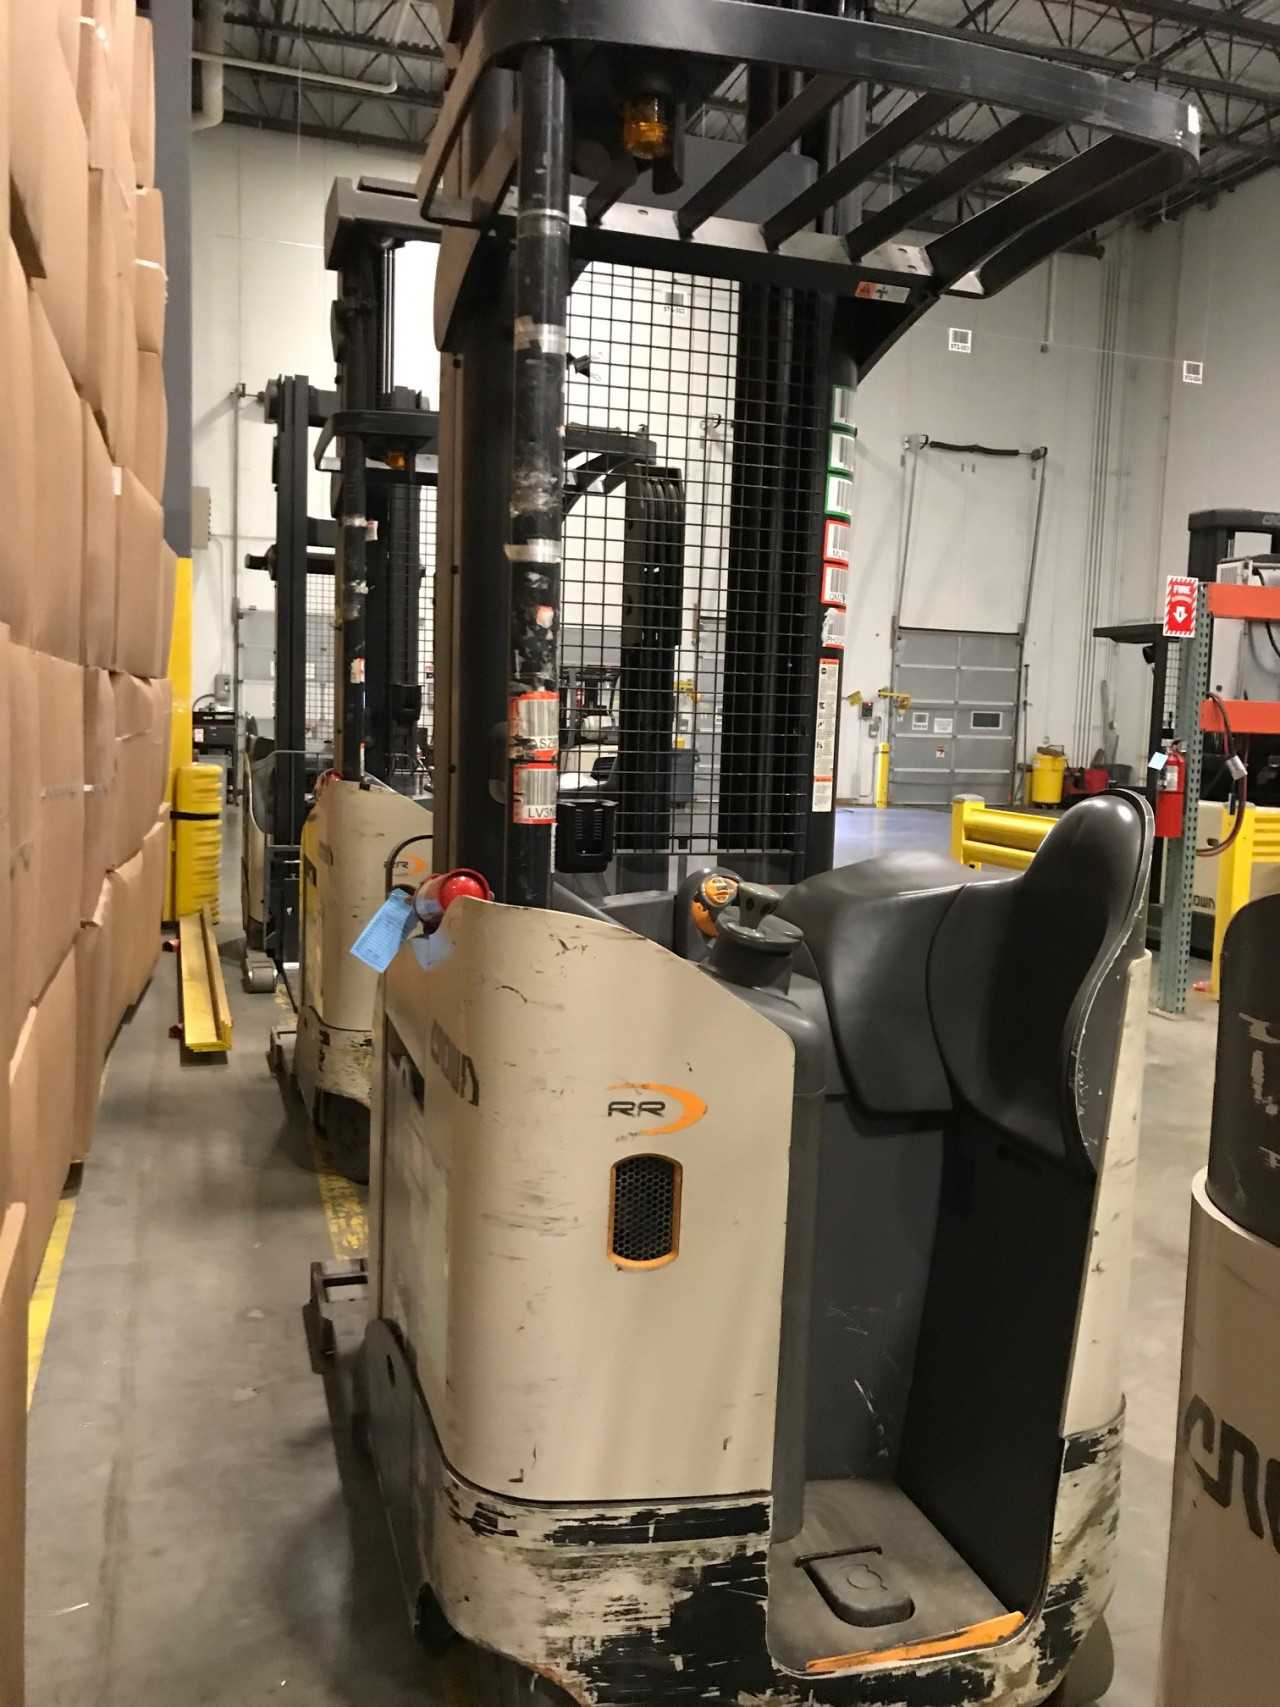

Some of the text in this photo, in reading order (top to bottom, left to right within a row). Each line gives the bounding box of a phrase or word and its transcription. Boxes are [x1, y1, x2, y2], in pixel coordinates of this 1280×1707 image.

[1173, 584, 1192, 594] FIRE
[1193, 895, 1216, 910] OWN
[608, 1101, 666, 1118] RR
